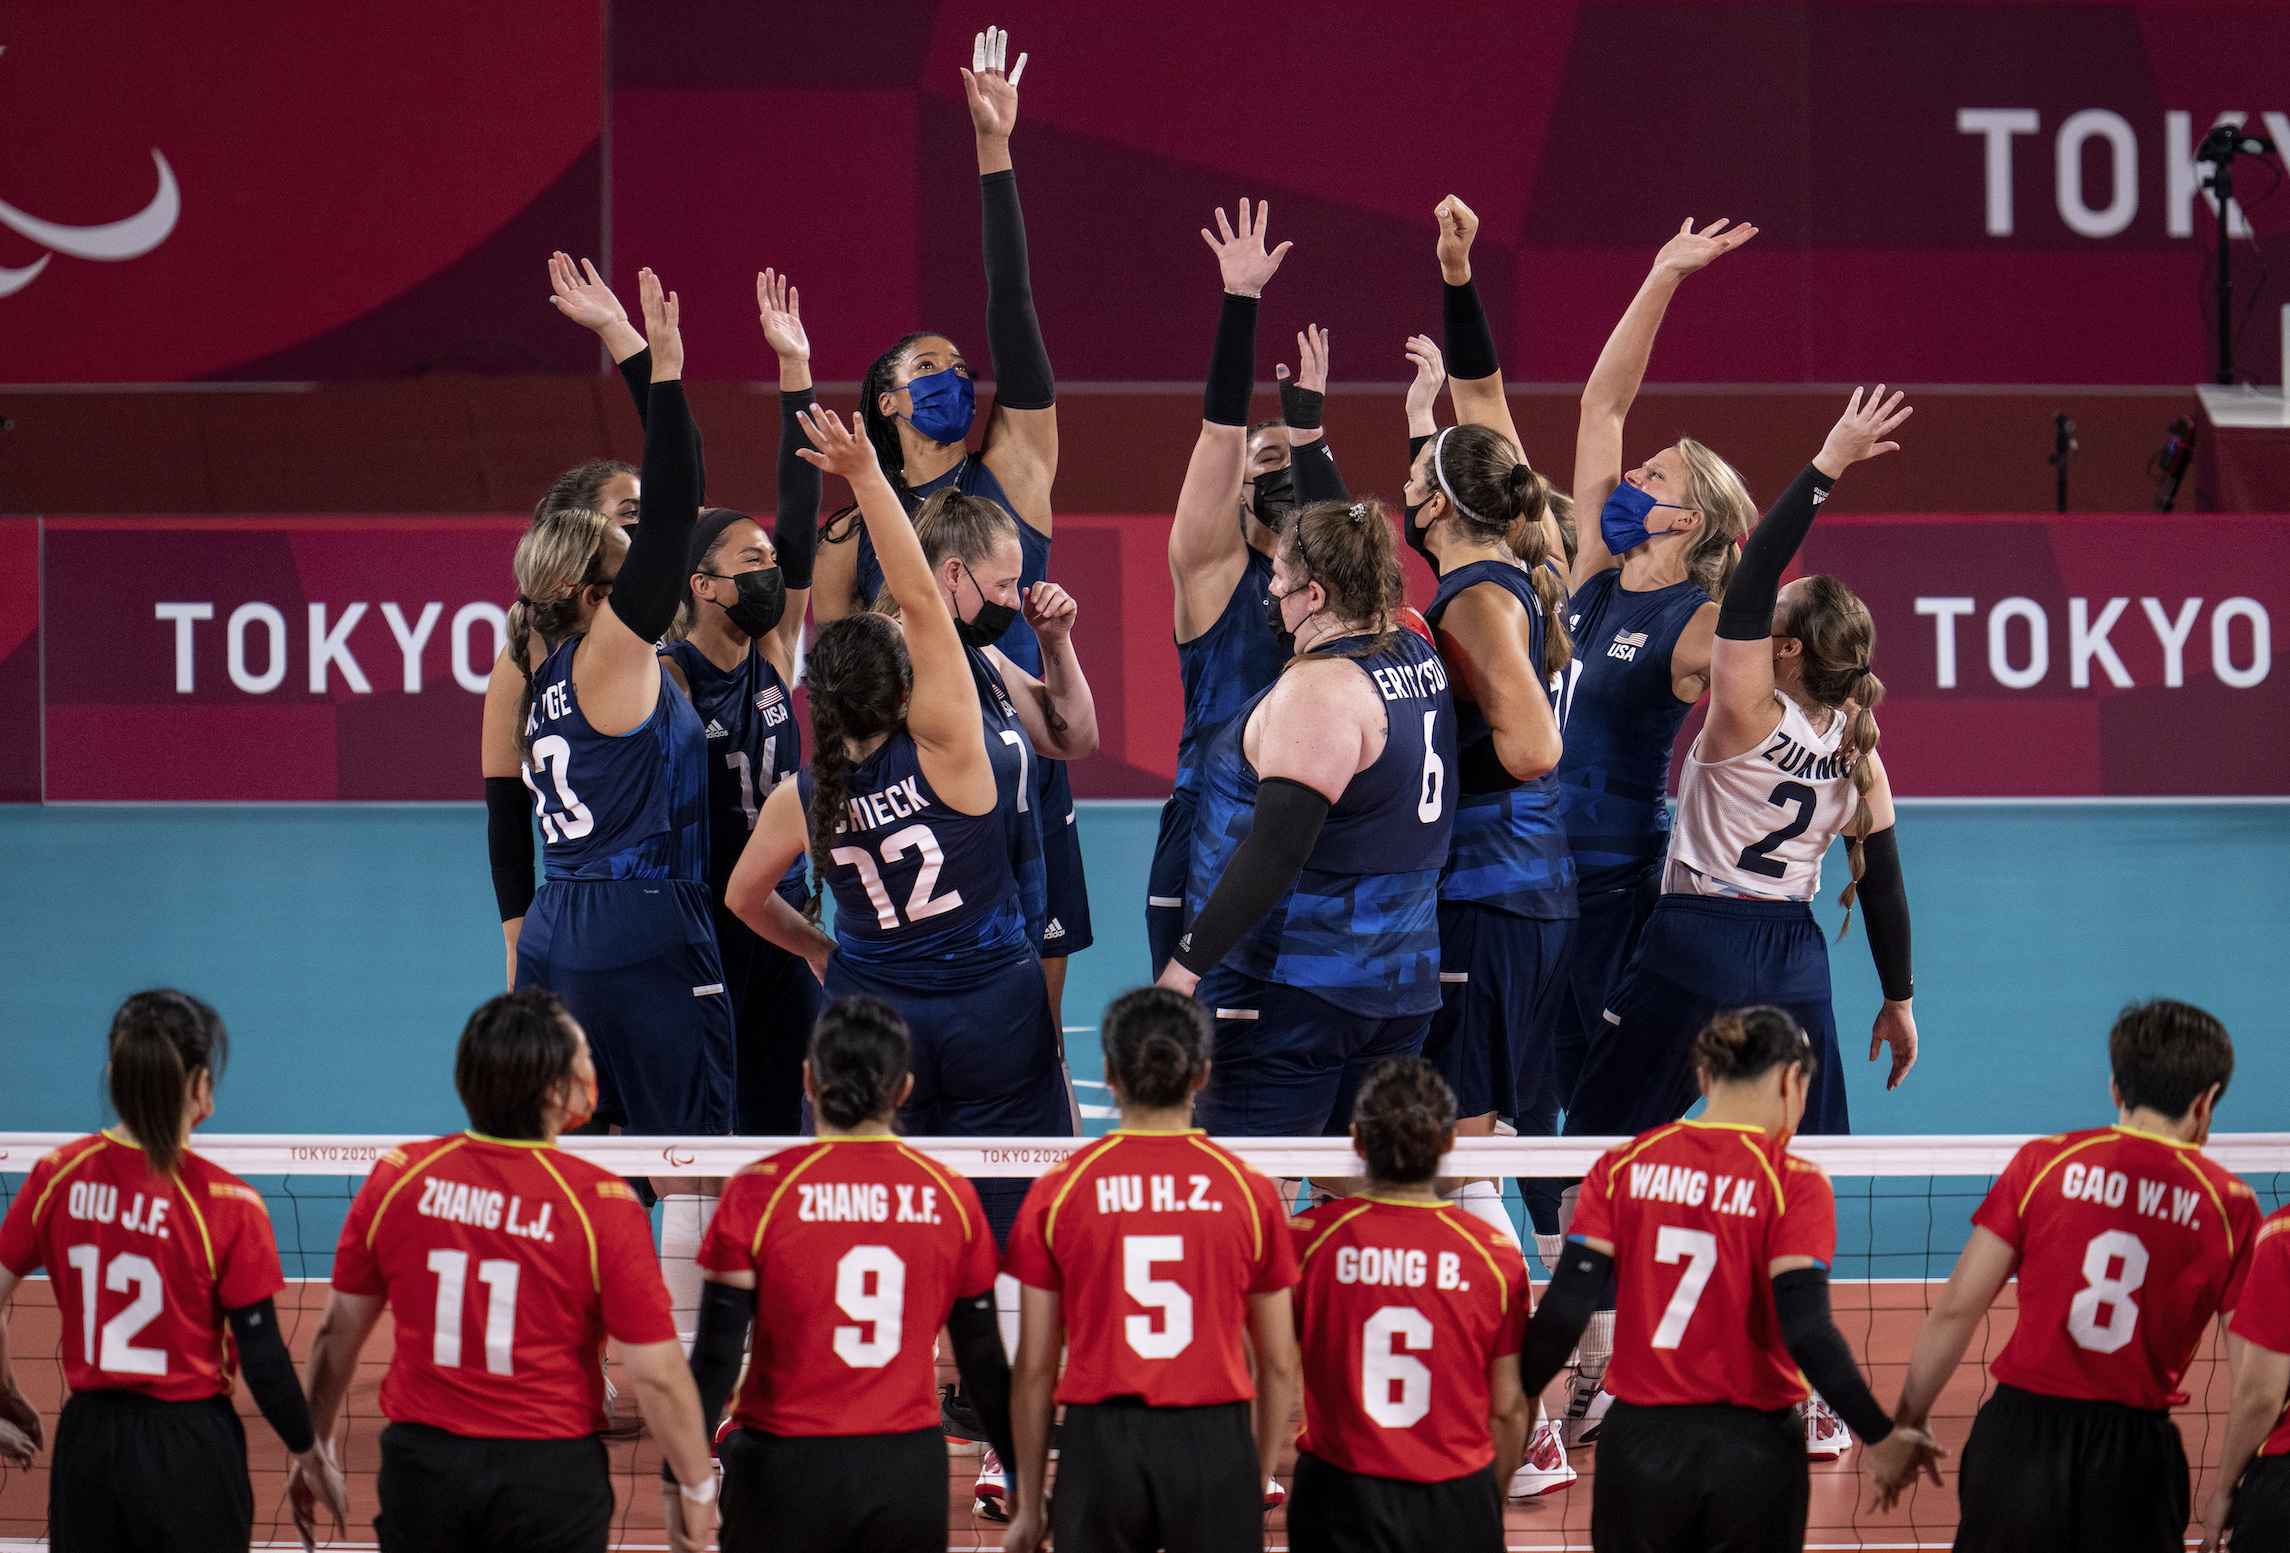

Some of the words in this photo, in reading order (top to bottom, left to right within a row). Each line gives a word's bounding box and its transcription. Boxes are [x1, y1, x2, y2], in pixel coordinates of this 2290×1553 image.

[155, 602, 507, 694] TOKYO
[1372, 655, 1449, 700] ERICKSO
[1607, 643, 1637, 662] USA
[1914, 596, 2271, 689] TOKYO
[763, 702, 788, 727] USA
[1417, 710, 1444, 824] 6
[1736, 780, 1817, 879] 2
[830, 823, 964, 930] 12
[289, 1147, 338, 1160] TOKYO
[341, 1147, 376, 1160] 2020
[982, 1150, 1030, 1163] TOKYO
[1034, 1150, 1069, 1163] 2020
[1629, 1162, 1706, 1207] WANG
[1709, 1173, 1758, 1218] Y.N.
[68, 1181, 114, 1224] QIU
[121, 1193, 170, 1239] J.F.
[418, 1177, 503, 1229] ZHANG
[505, 1199, 555, 1243] L.J.
[798, 1183, 889, 1223] ZHANG
[896, 1184, 942, 1225] X.F.
[1096, 1175, 1141, 1214] HU
[1150, 1174, 1223, 1212] H.Z.
[2062, 1162, 2128, 1208] GAO
[2137, 1177, 2201, 1231] W.W.
[832, 1244, 907, 1369] 9
[1122, 1235, 1194, 1359] 5
[1335, 1246, 1428, 1288] GONG
[1437, 1250, 1470, 1292] B.
[1651, 1225, 1720, 1350] 7
[2067, 1228, 2150, 1355] 8
[67, 1243, 169, 1376] 12
[427, 1247, 521, 1377] 11
[1362, 1305, 1434, 1429] 6
